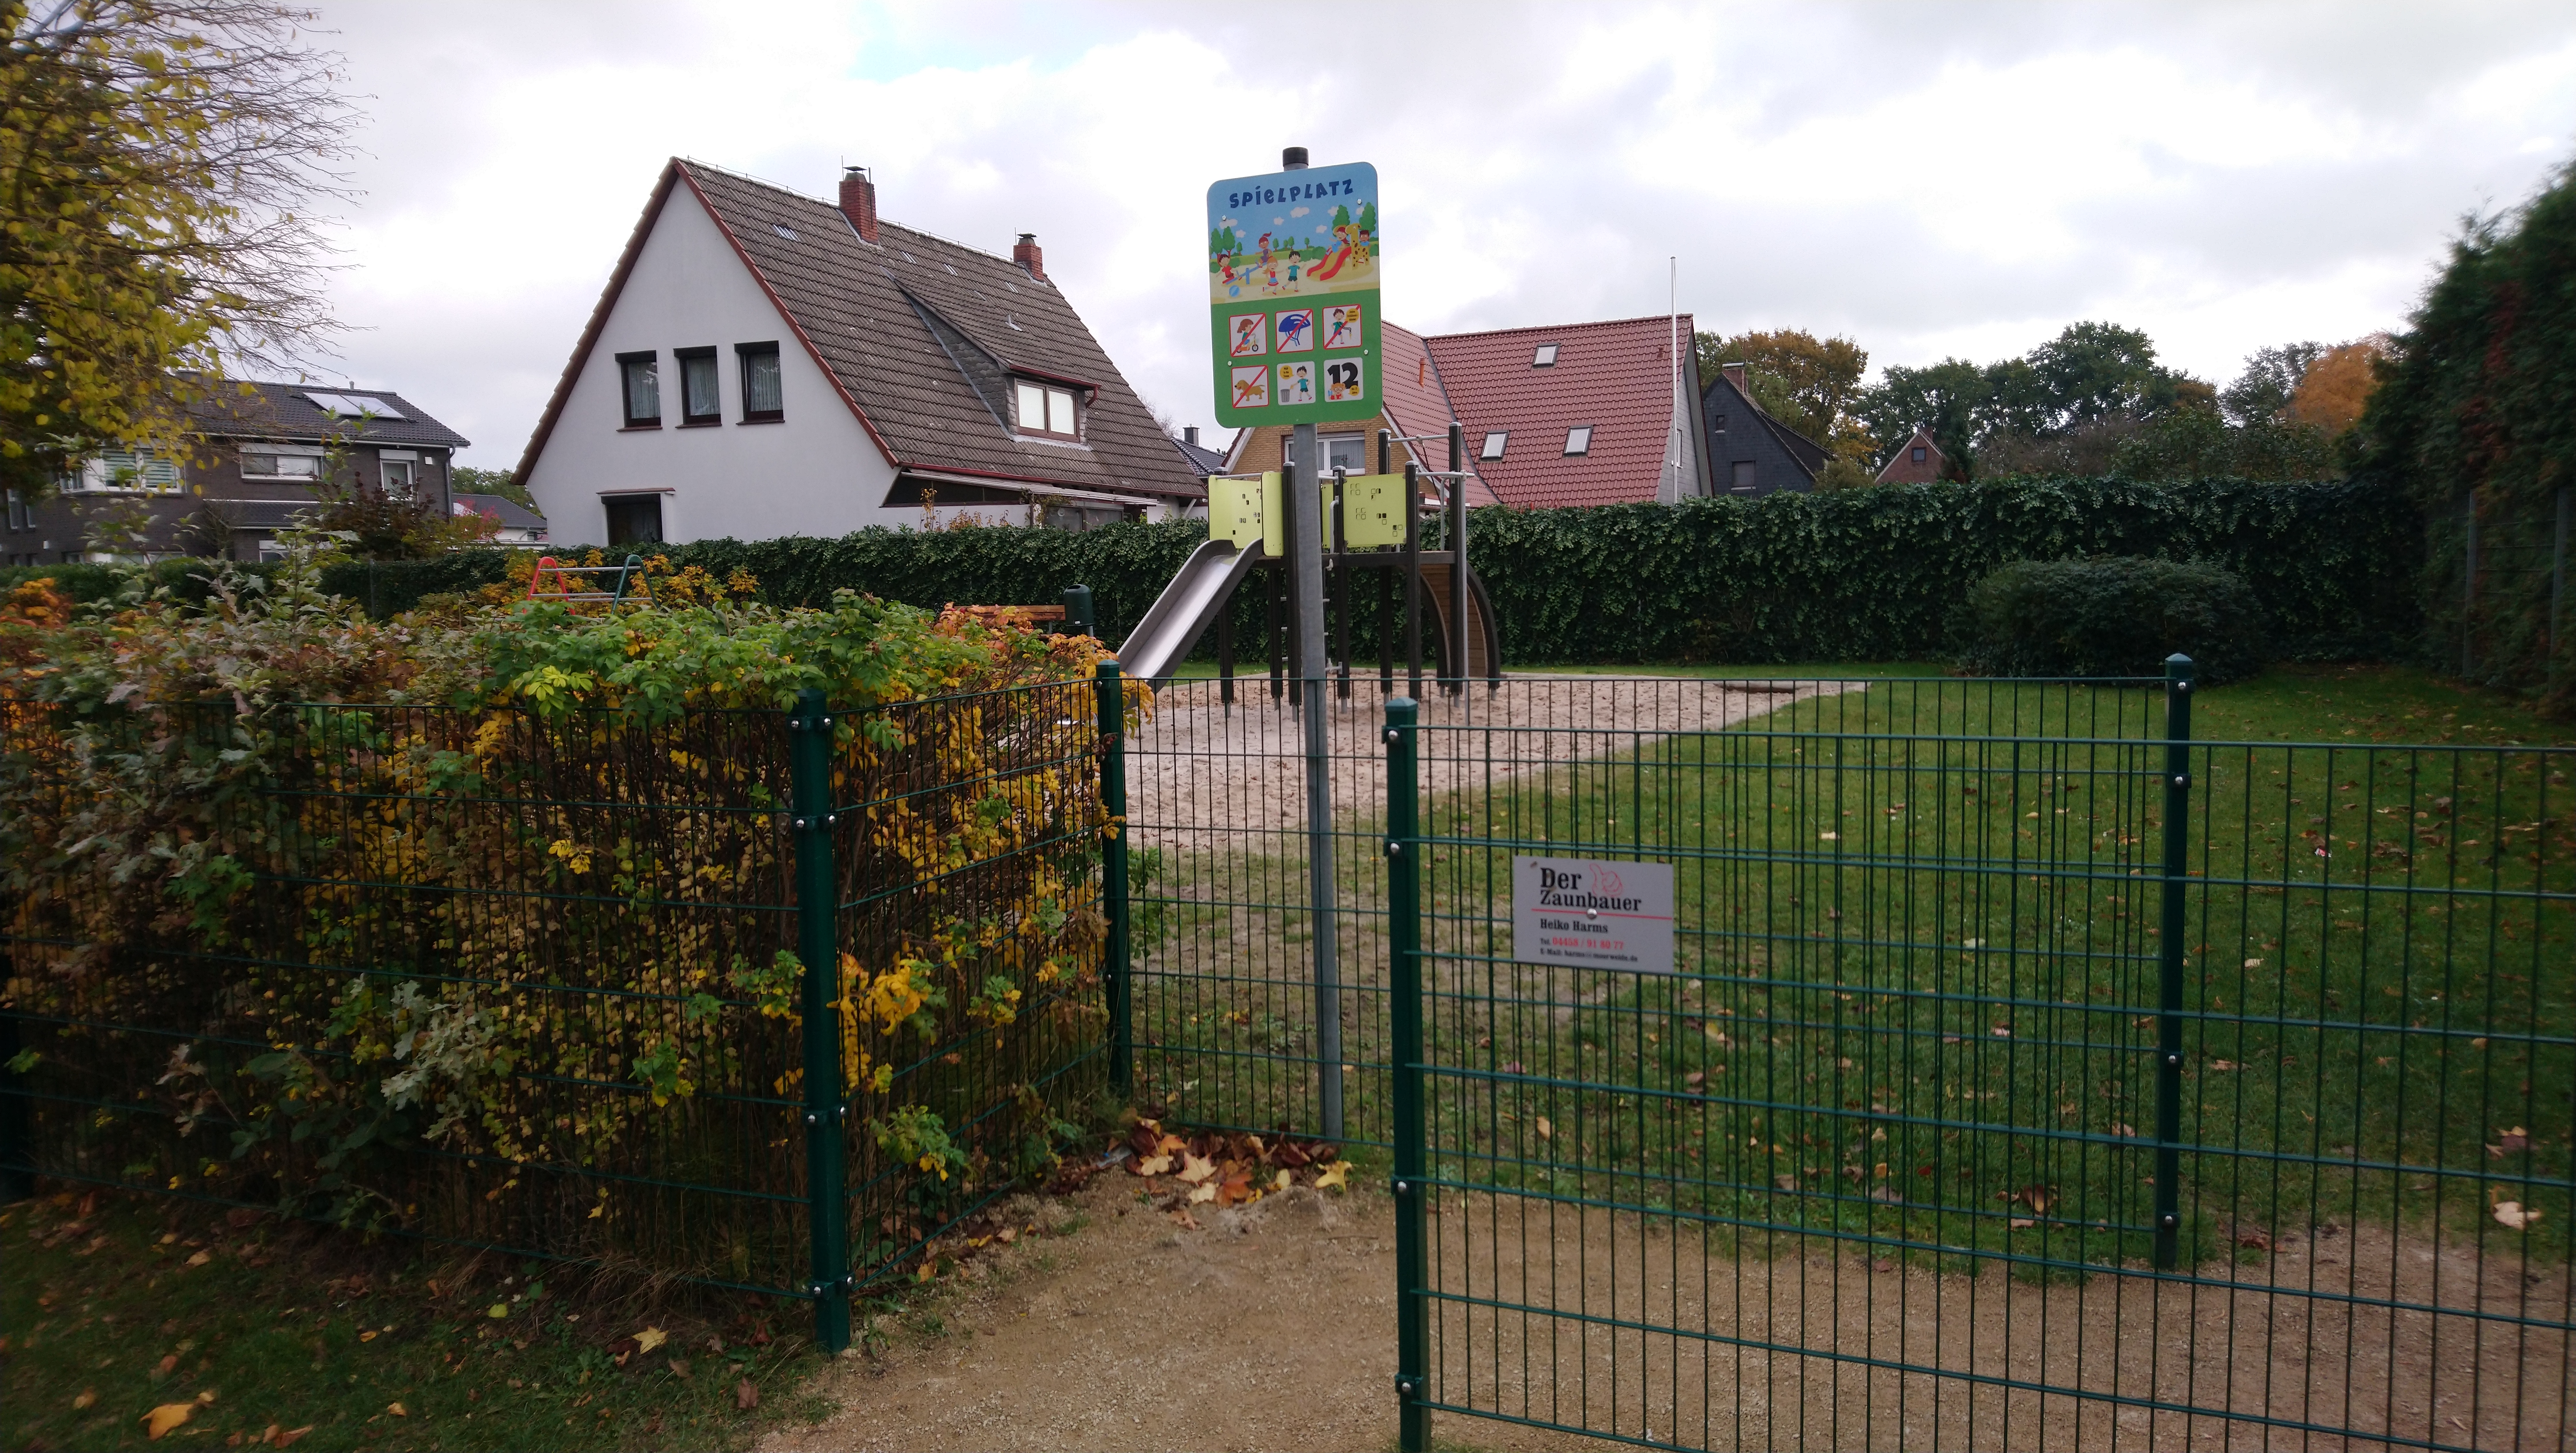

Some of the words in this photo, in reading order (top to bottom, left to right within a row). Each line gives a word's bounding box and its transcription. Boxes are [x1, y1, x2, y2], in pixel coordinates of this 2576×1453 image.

[1327, 362, 1358, 390] 12
[1540, 867, 1582, 890] Der
[1540, 889, 1642, 912] Zaunbauer
[1540, 918, 1570, 931] Heiko
[1572, 920, 1608, 934] Harms
[1613, 940, 1624, 950] 77
